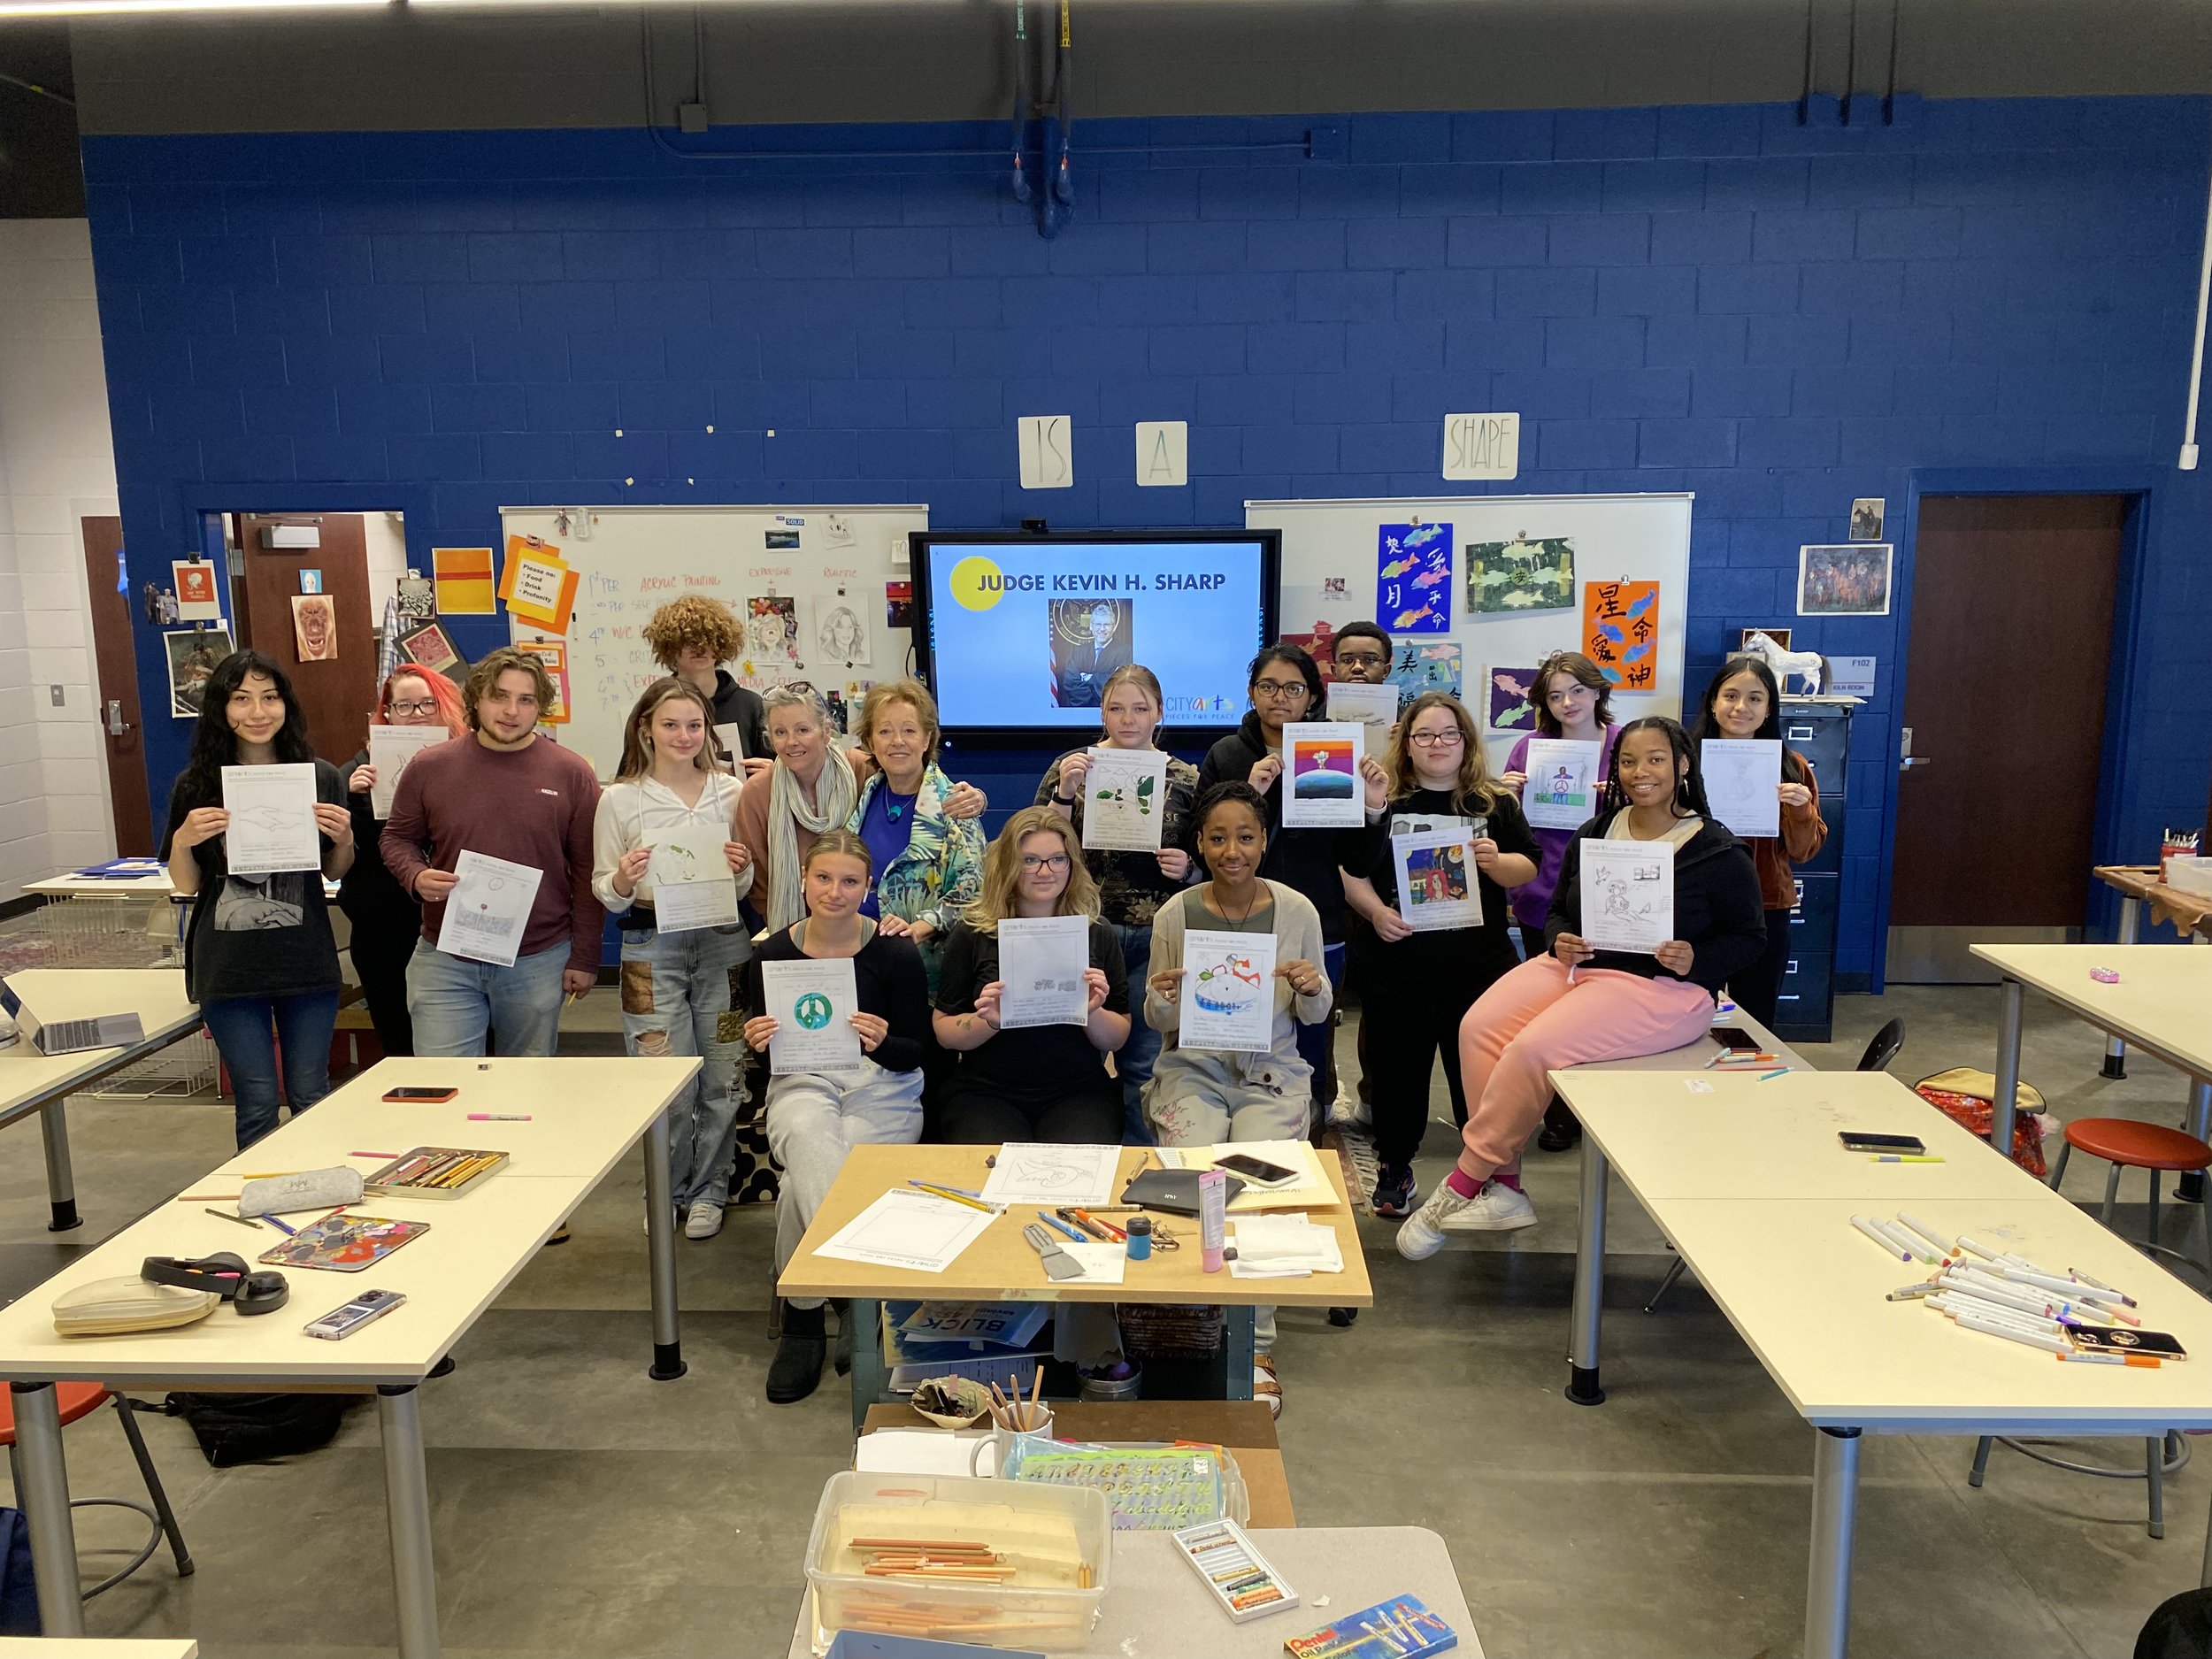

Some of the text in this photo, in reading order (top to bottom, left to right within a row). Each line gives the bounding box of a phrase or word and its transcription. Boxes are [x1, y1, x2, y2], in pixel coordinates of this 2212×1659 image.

[1038, 419, 1066, 482] IS
[1450, 419, 1510, 469] SHAPE
[1149, 430, 1172, 479] A
[522, 564, 544, 574] Please
[526, 573, 542, 582] Food
[749, 568, 793, 577] EXPRESSIVE
[525, 581, 541, 590] Drink
[641, 576, 677, 592] ACRYLIC
[684, 574, 721, 587] PAINTING
[977, 573, 1226, 591] JUDGE KEVIN H. SHARP
[522, 589, 552, 603] Profanity
[1596, 584, 1626, 619] 星
[1632, 616, 1653, 643] 命
[1397, 650, 1417, 672] 美
[738, 676, 764, 688] MEDIA
[1627, 664, 1651, 687] 神
[920, 1317, 1007, 1333] BLICK
[1290, 1628, 1340, 1652] Pentel
[1301, 1648, 1316, 1658] Oil
